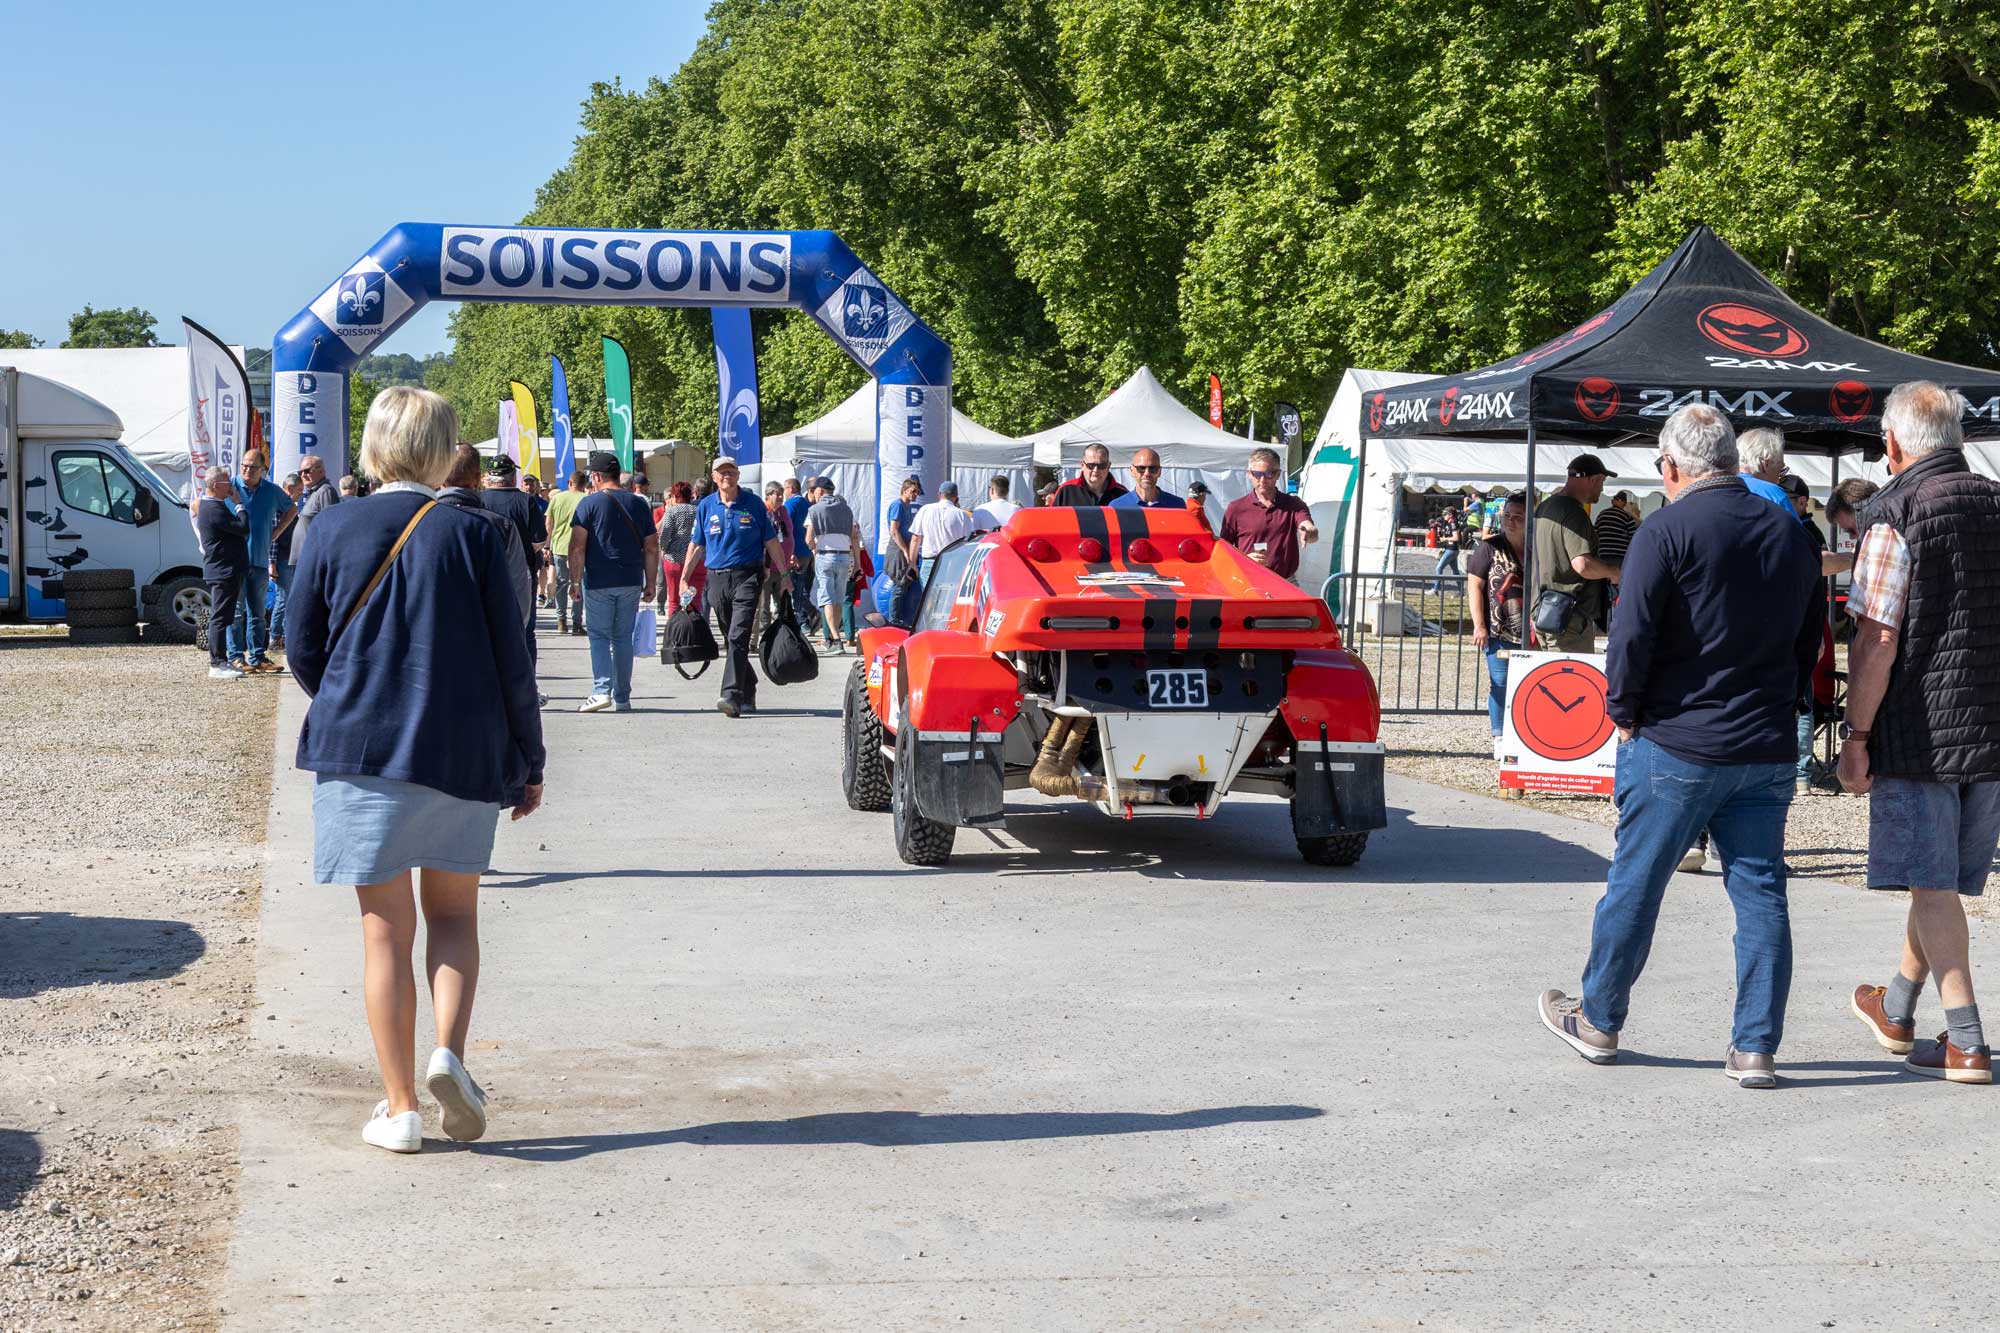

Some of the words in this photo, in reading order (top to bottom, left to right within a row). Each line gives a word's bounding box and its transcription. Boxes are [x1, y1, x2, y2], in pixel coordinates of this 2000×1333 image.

[444, 234, 787, 293] SOISSONS
[336, 328, 383, 336] SOISSONS
[846, 340, 889, 350] SOISSONS
[1704, 356, 1871, 373] 24MX
[298, 373, 318, 454] DEP
[1385, 398, 1432, 425] 24MX
[1456, 391, 1515, 420] 24MX
[1638, 389, 1795, 418] 24MX
[1149, 673, 1205, 704] 285
